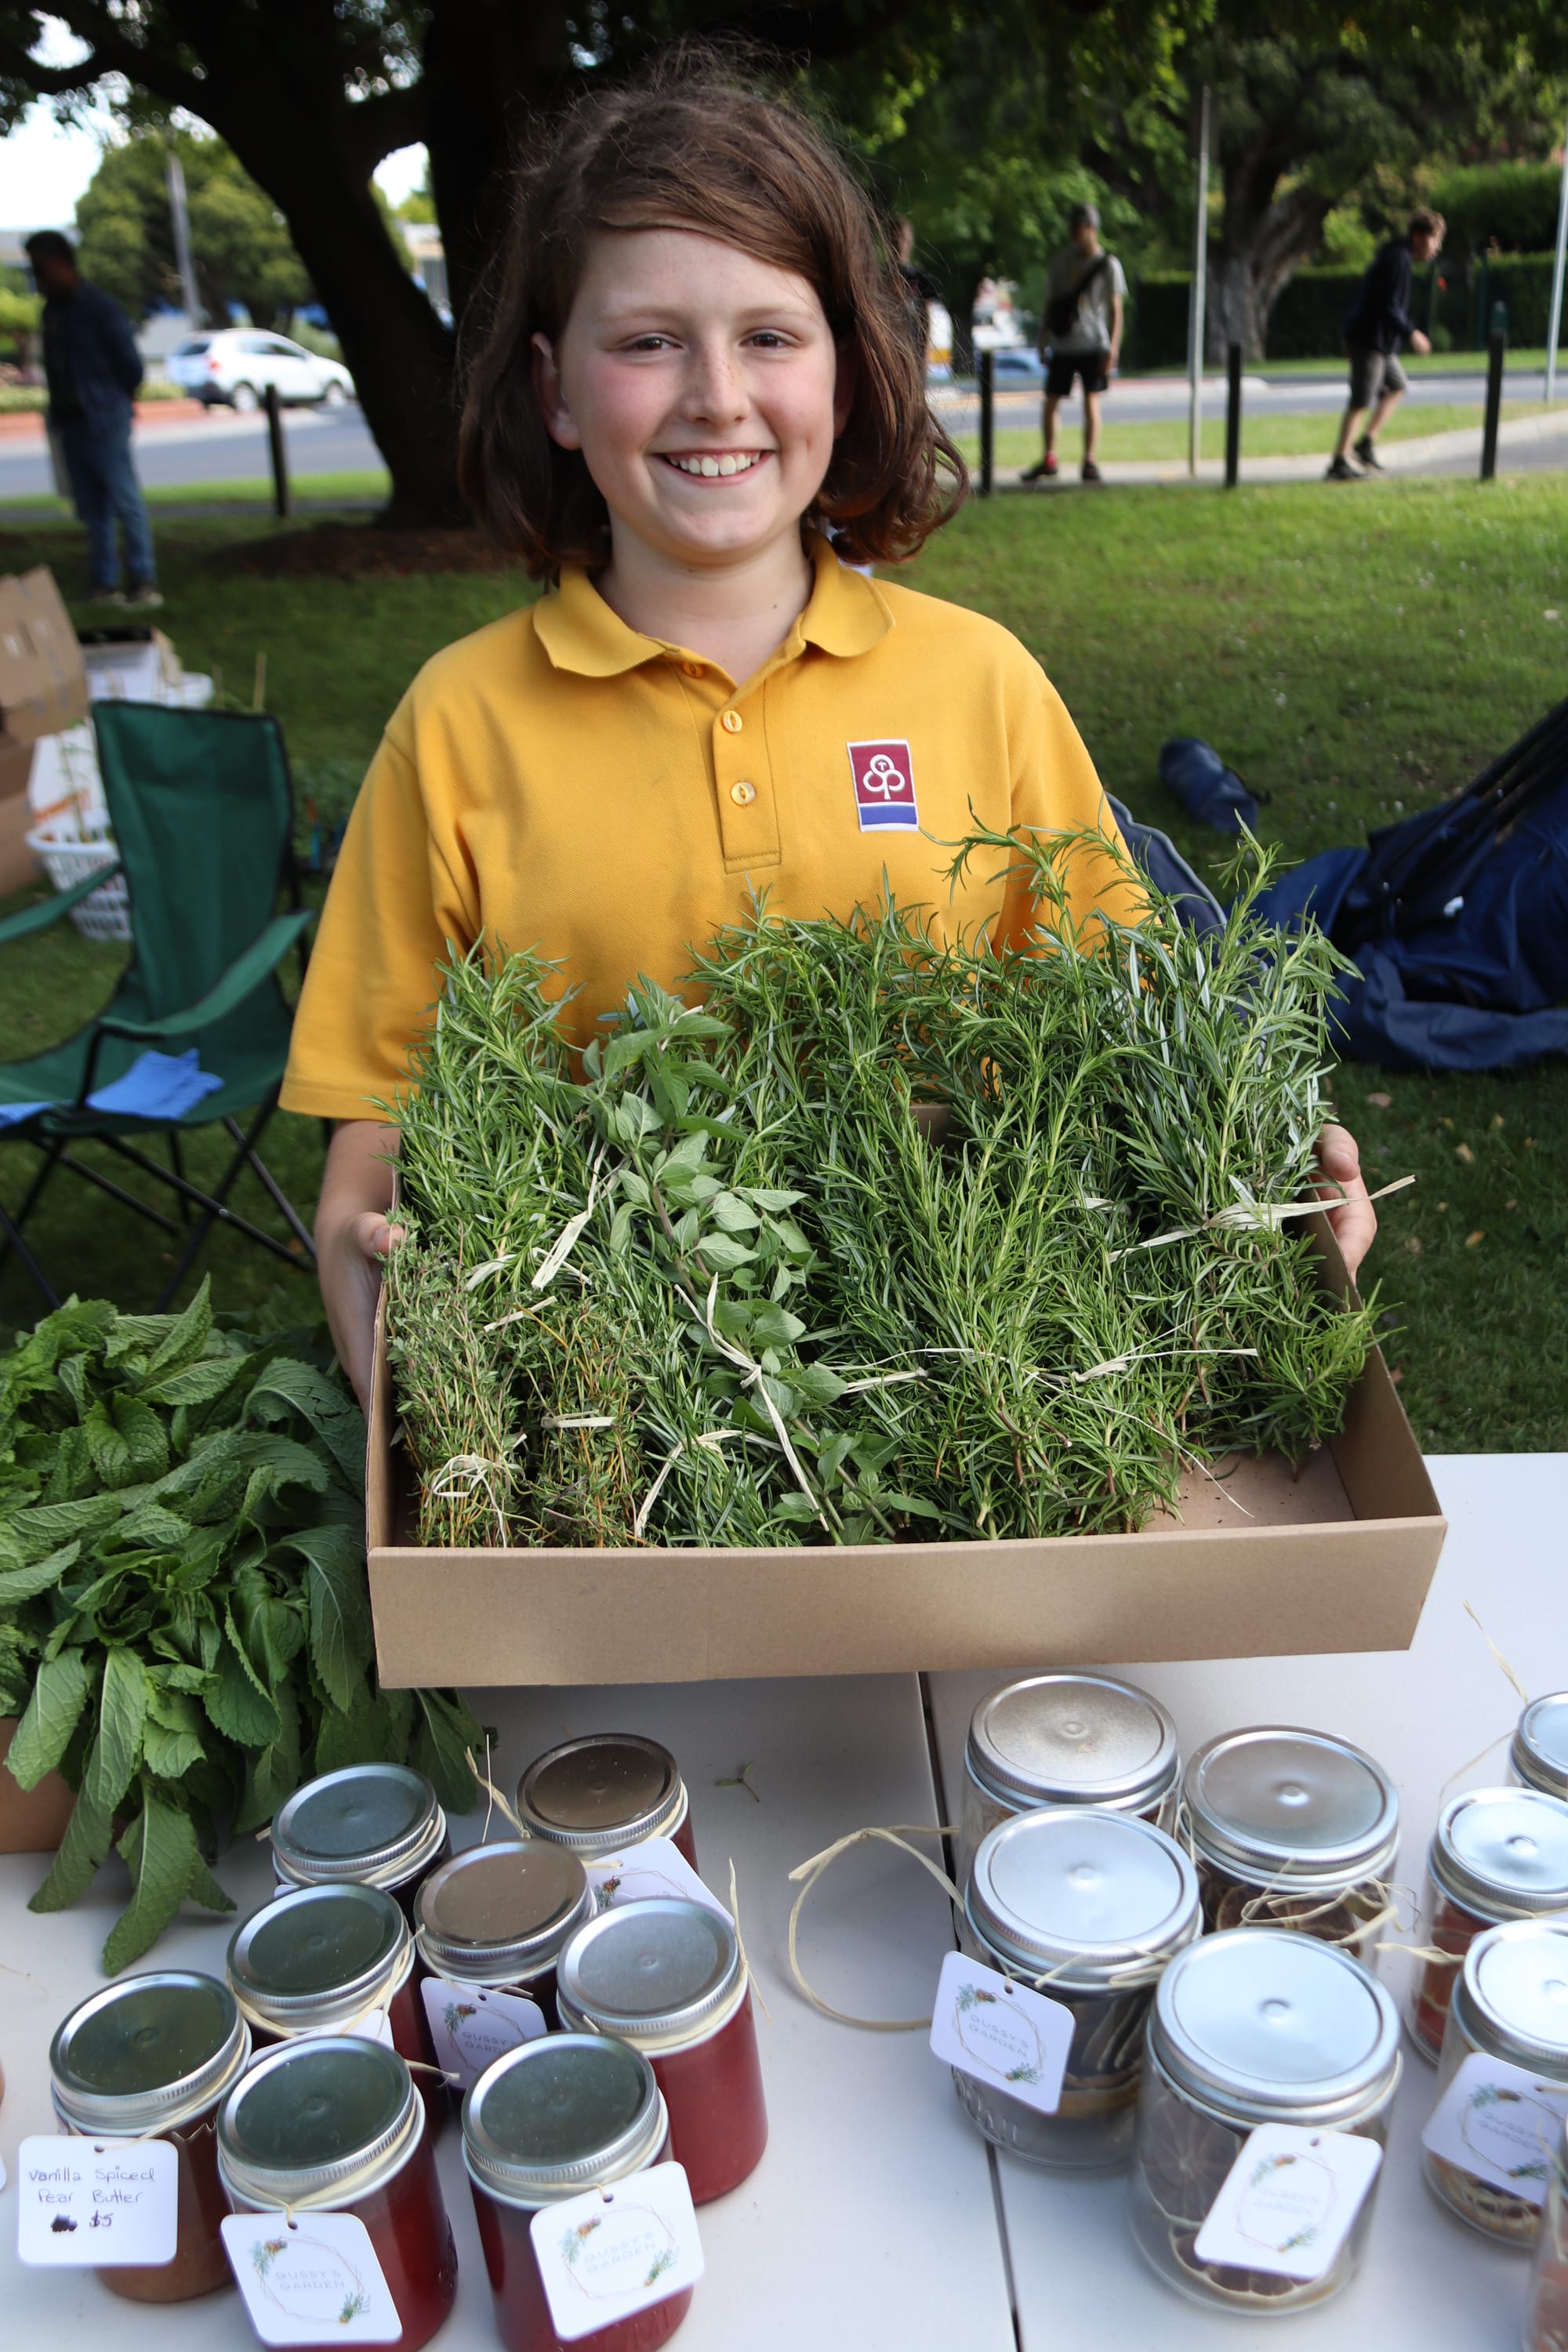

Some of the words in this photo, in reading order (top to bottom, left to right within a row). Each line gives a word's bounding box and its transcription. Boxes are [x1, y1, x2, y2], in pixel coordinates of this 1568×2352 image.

[969, 2024, 1027, 2056] GARDEN
[971, 2015, 1029, 2048] GUSSY'S
[464, 2041, 503, 2053] GARD
[95, 2165, 156, 2183] Spiced
[38, 2188, 74, 2204] Pear
[93, 2188, 143, 2204] Butter
[89, 2209, 114, 2227] $5
[279, 2281, 346, 2289] GARDEN
